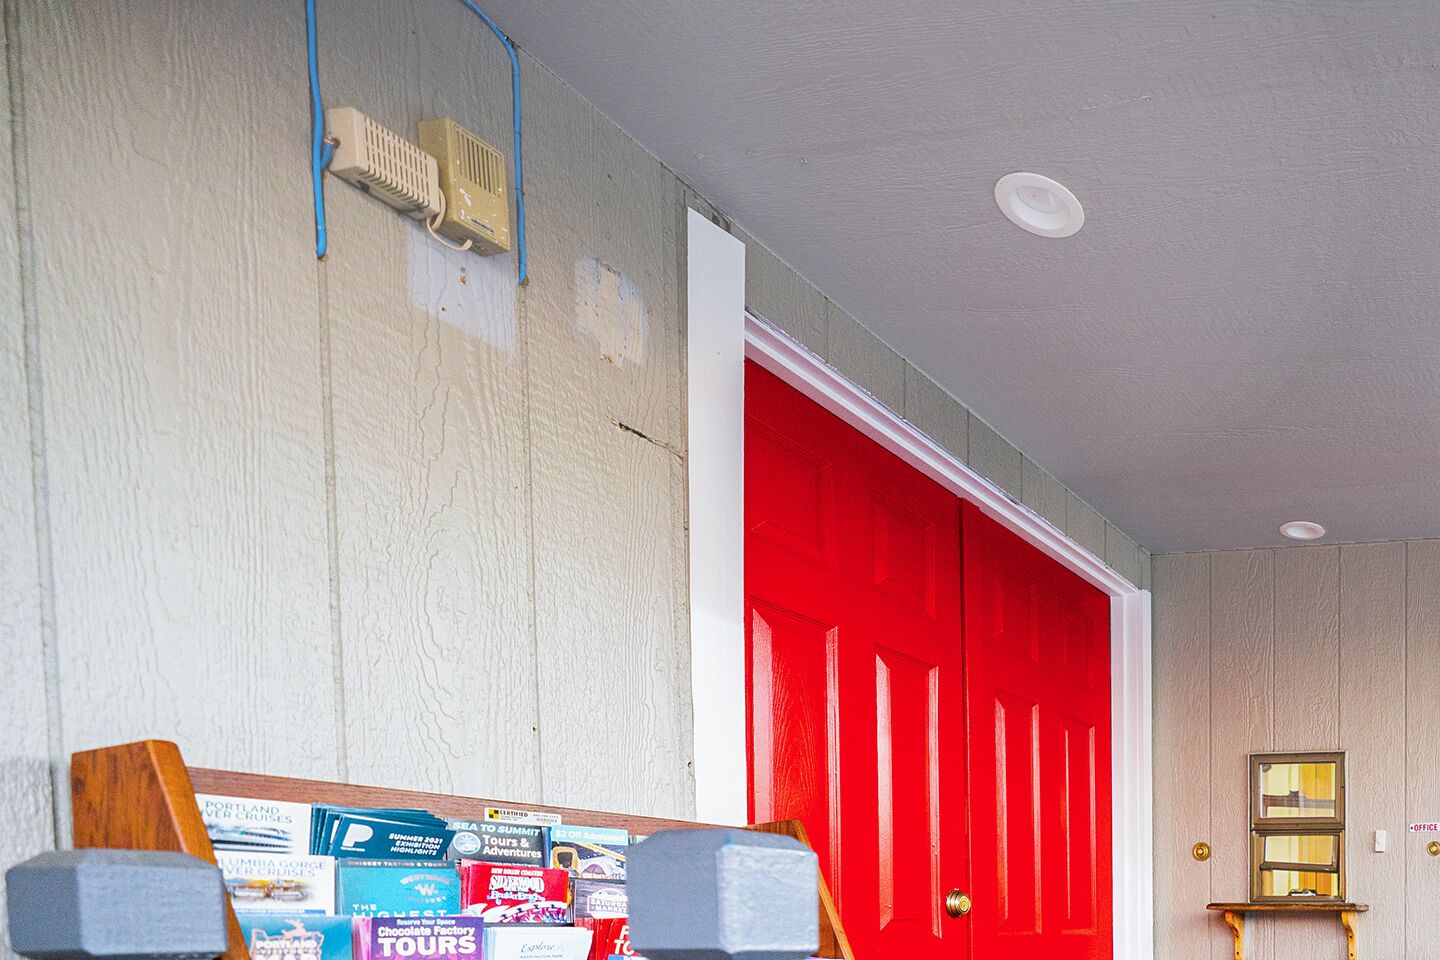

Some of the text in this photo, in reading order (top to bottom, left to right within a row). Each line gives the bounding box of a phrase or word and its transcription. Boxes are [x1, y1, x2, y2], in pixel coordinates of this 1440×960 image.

[205, 800, 280, 815] PORTLAND
[202, 809, 293, 823] VER CRUISES
[452, 822, 541, 836] SEA TO SUMMIT
[1414, 823, 1438, 832] OFFICE
[388, 832, 423, 843] SUMMER
[482, 834, 530, 848] Tours &
[390, 846, 438, 856] HIGHLIGHTS
[395, 840, 441, 850] EXHIBITION
[482, 846, 542, 859] Adventures
[220, 858, 326, 871] LUMBIA GORGE
[225, 866, 253, 875] VER
[377, 926, 476, 938] Chocolate Factory
[377, 935, 477, 957] TOURS
